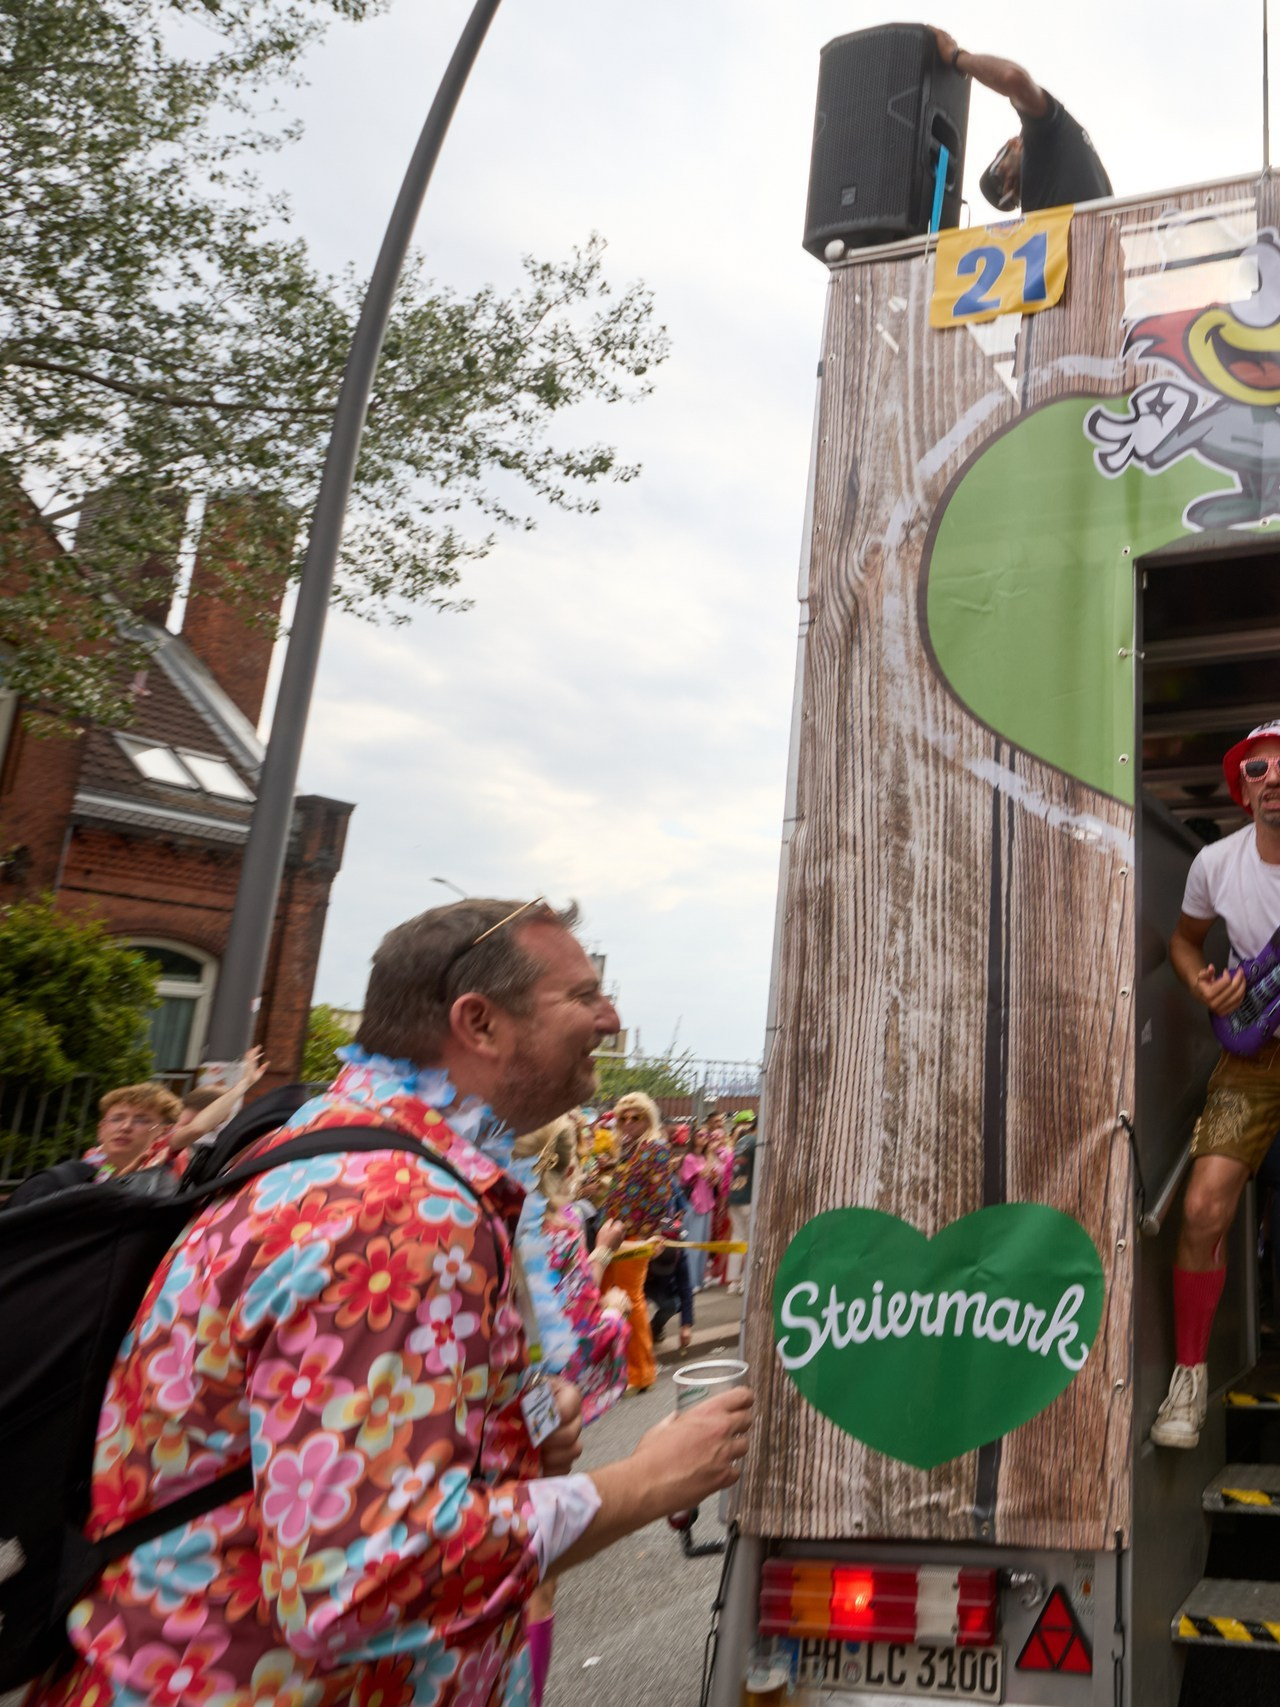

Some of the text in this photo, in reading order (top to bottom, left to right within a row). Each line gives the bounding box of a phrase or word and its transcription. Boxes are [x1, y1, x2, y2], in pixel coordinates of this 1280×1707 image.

[952, 231, 1048, 317] 21
[776, 1280, 1090, 1371] Steiermark
[800, 1638, 998, 1693] HH LC 3100
